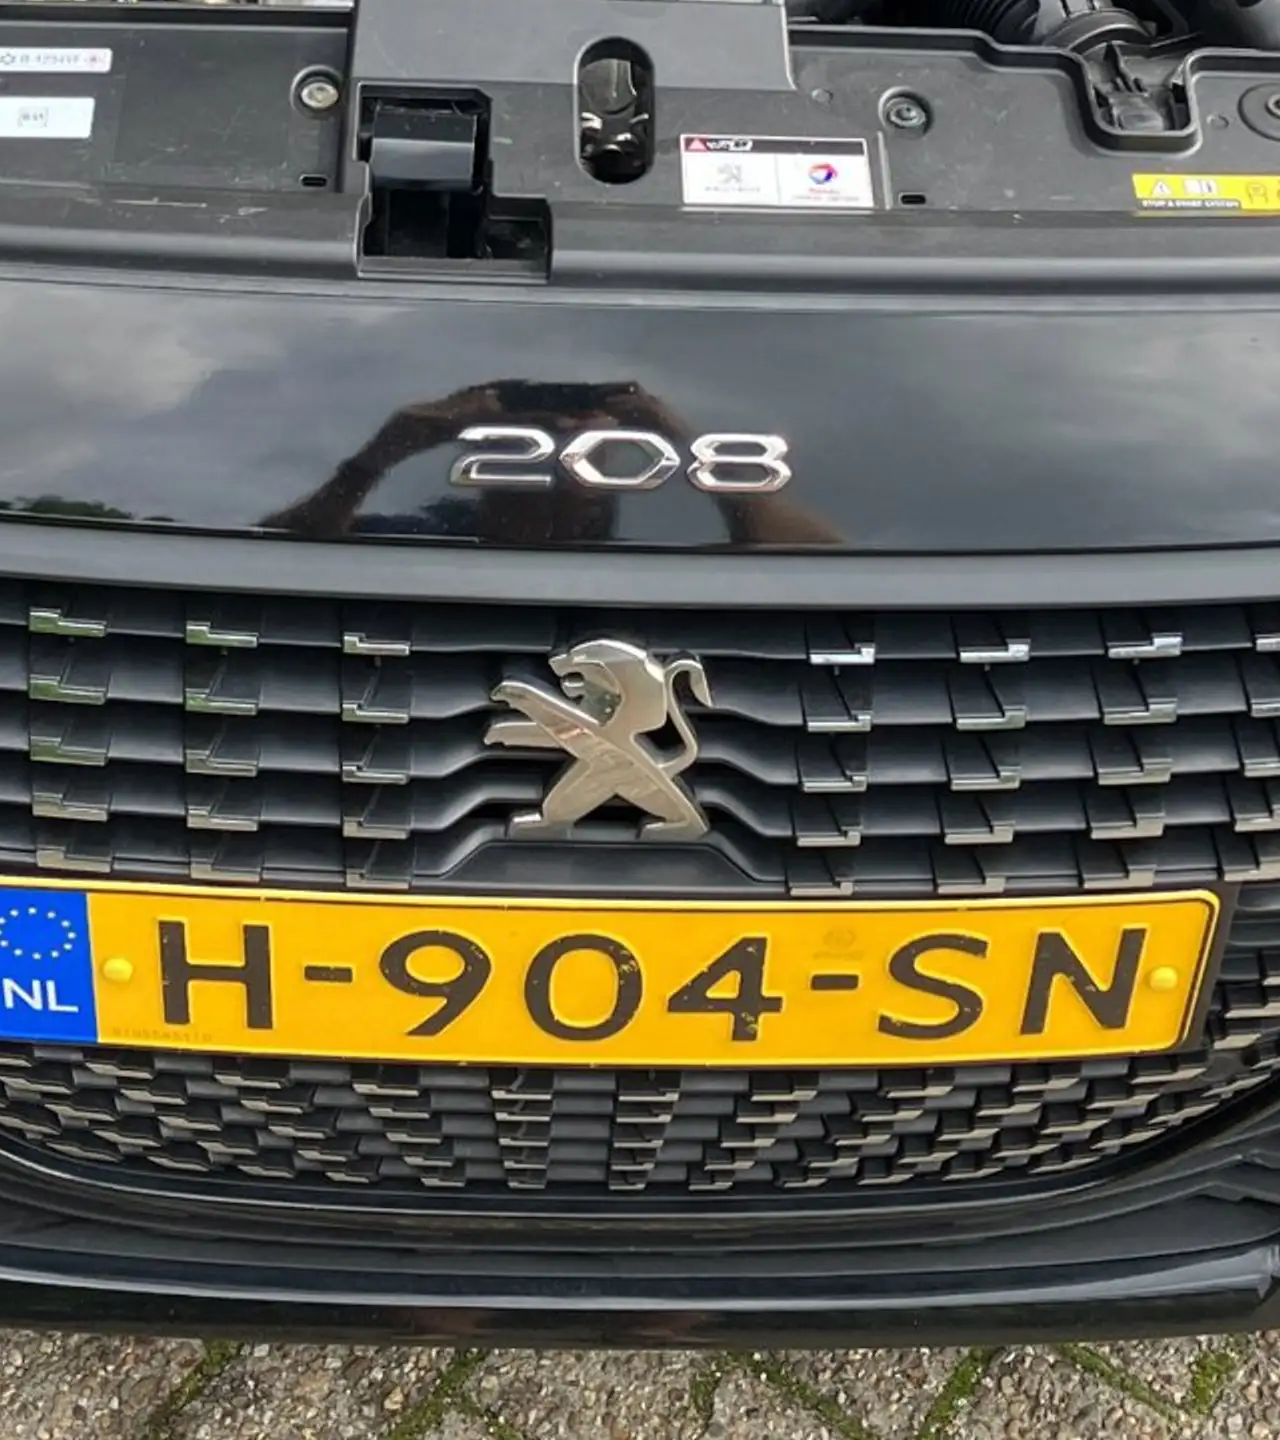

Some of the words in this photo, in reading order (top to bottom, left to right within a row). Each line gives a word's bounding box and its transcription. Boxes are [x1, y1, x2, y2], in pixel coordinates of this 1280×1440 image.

[449, 426, 792, 494] 208
[2, 977, 79, 1013] NL
[157, 920, 1148, 1042] H-904-SN
